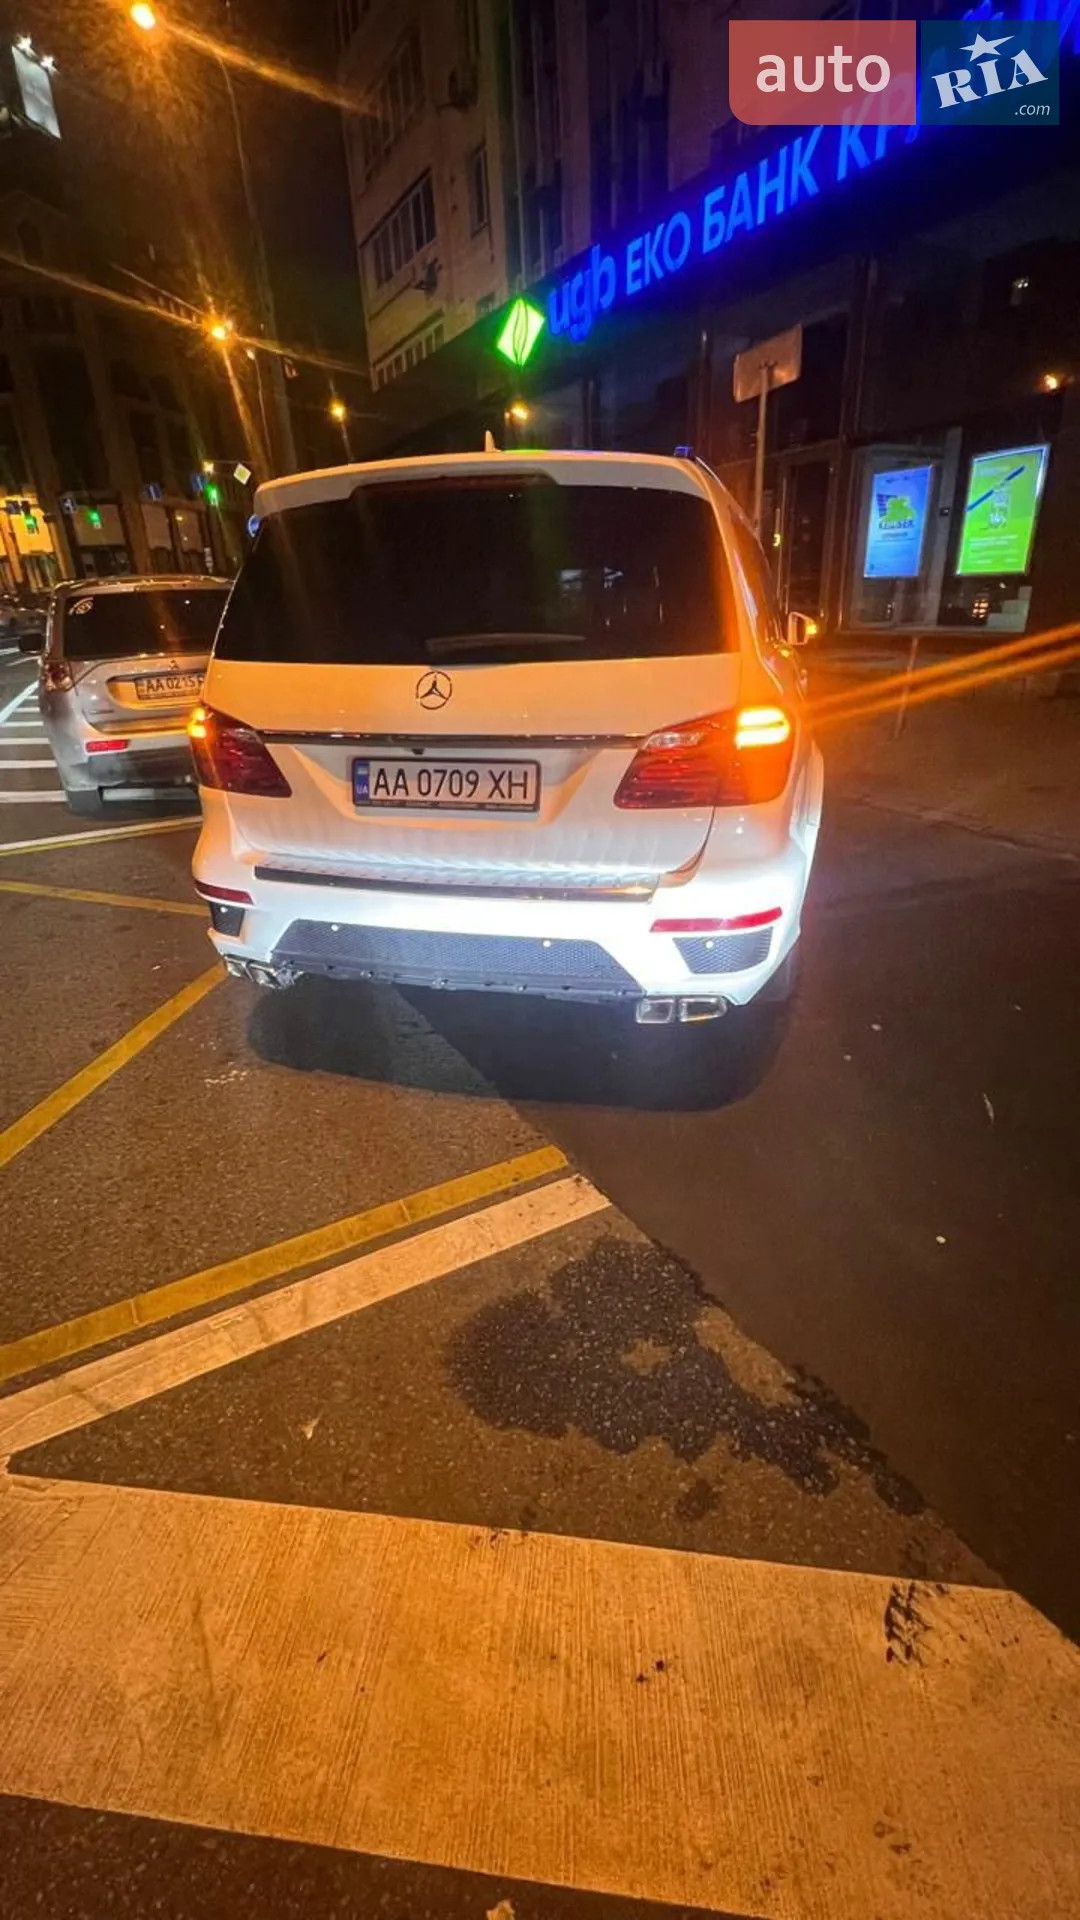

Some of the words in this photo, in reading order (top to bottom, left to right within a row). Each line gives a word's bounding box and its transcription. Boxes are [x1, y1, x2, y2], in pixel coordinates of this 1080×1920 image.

[548, 243, 616, 343] ugb
[626, 211, 691, 296] ЕКО
[702, 124, 824, 255] БАНК
[373, 767, 410, 797] AA
[416, 768, 480, 798] 0709
[487, 769, 528, 800] XH
